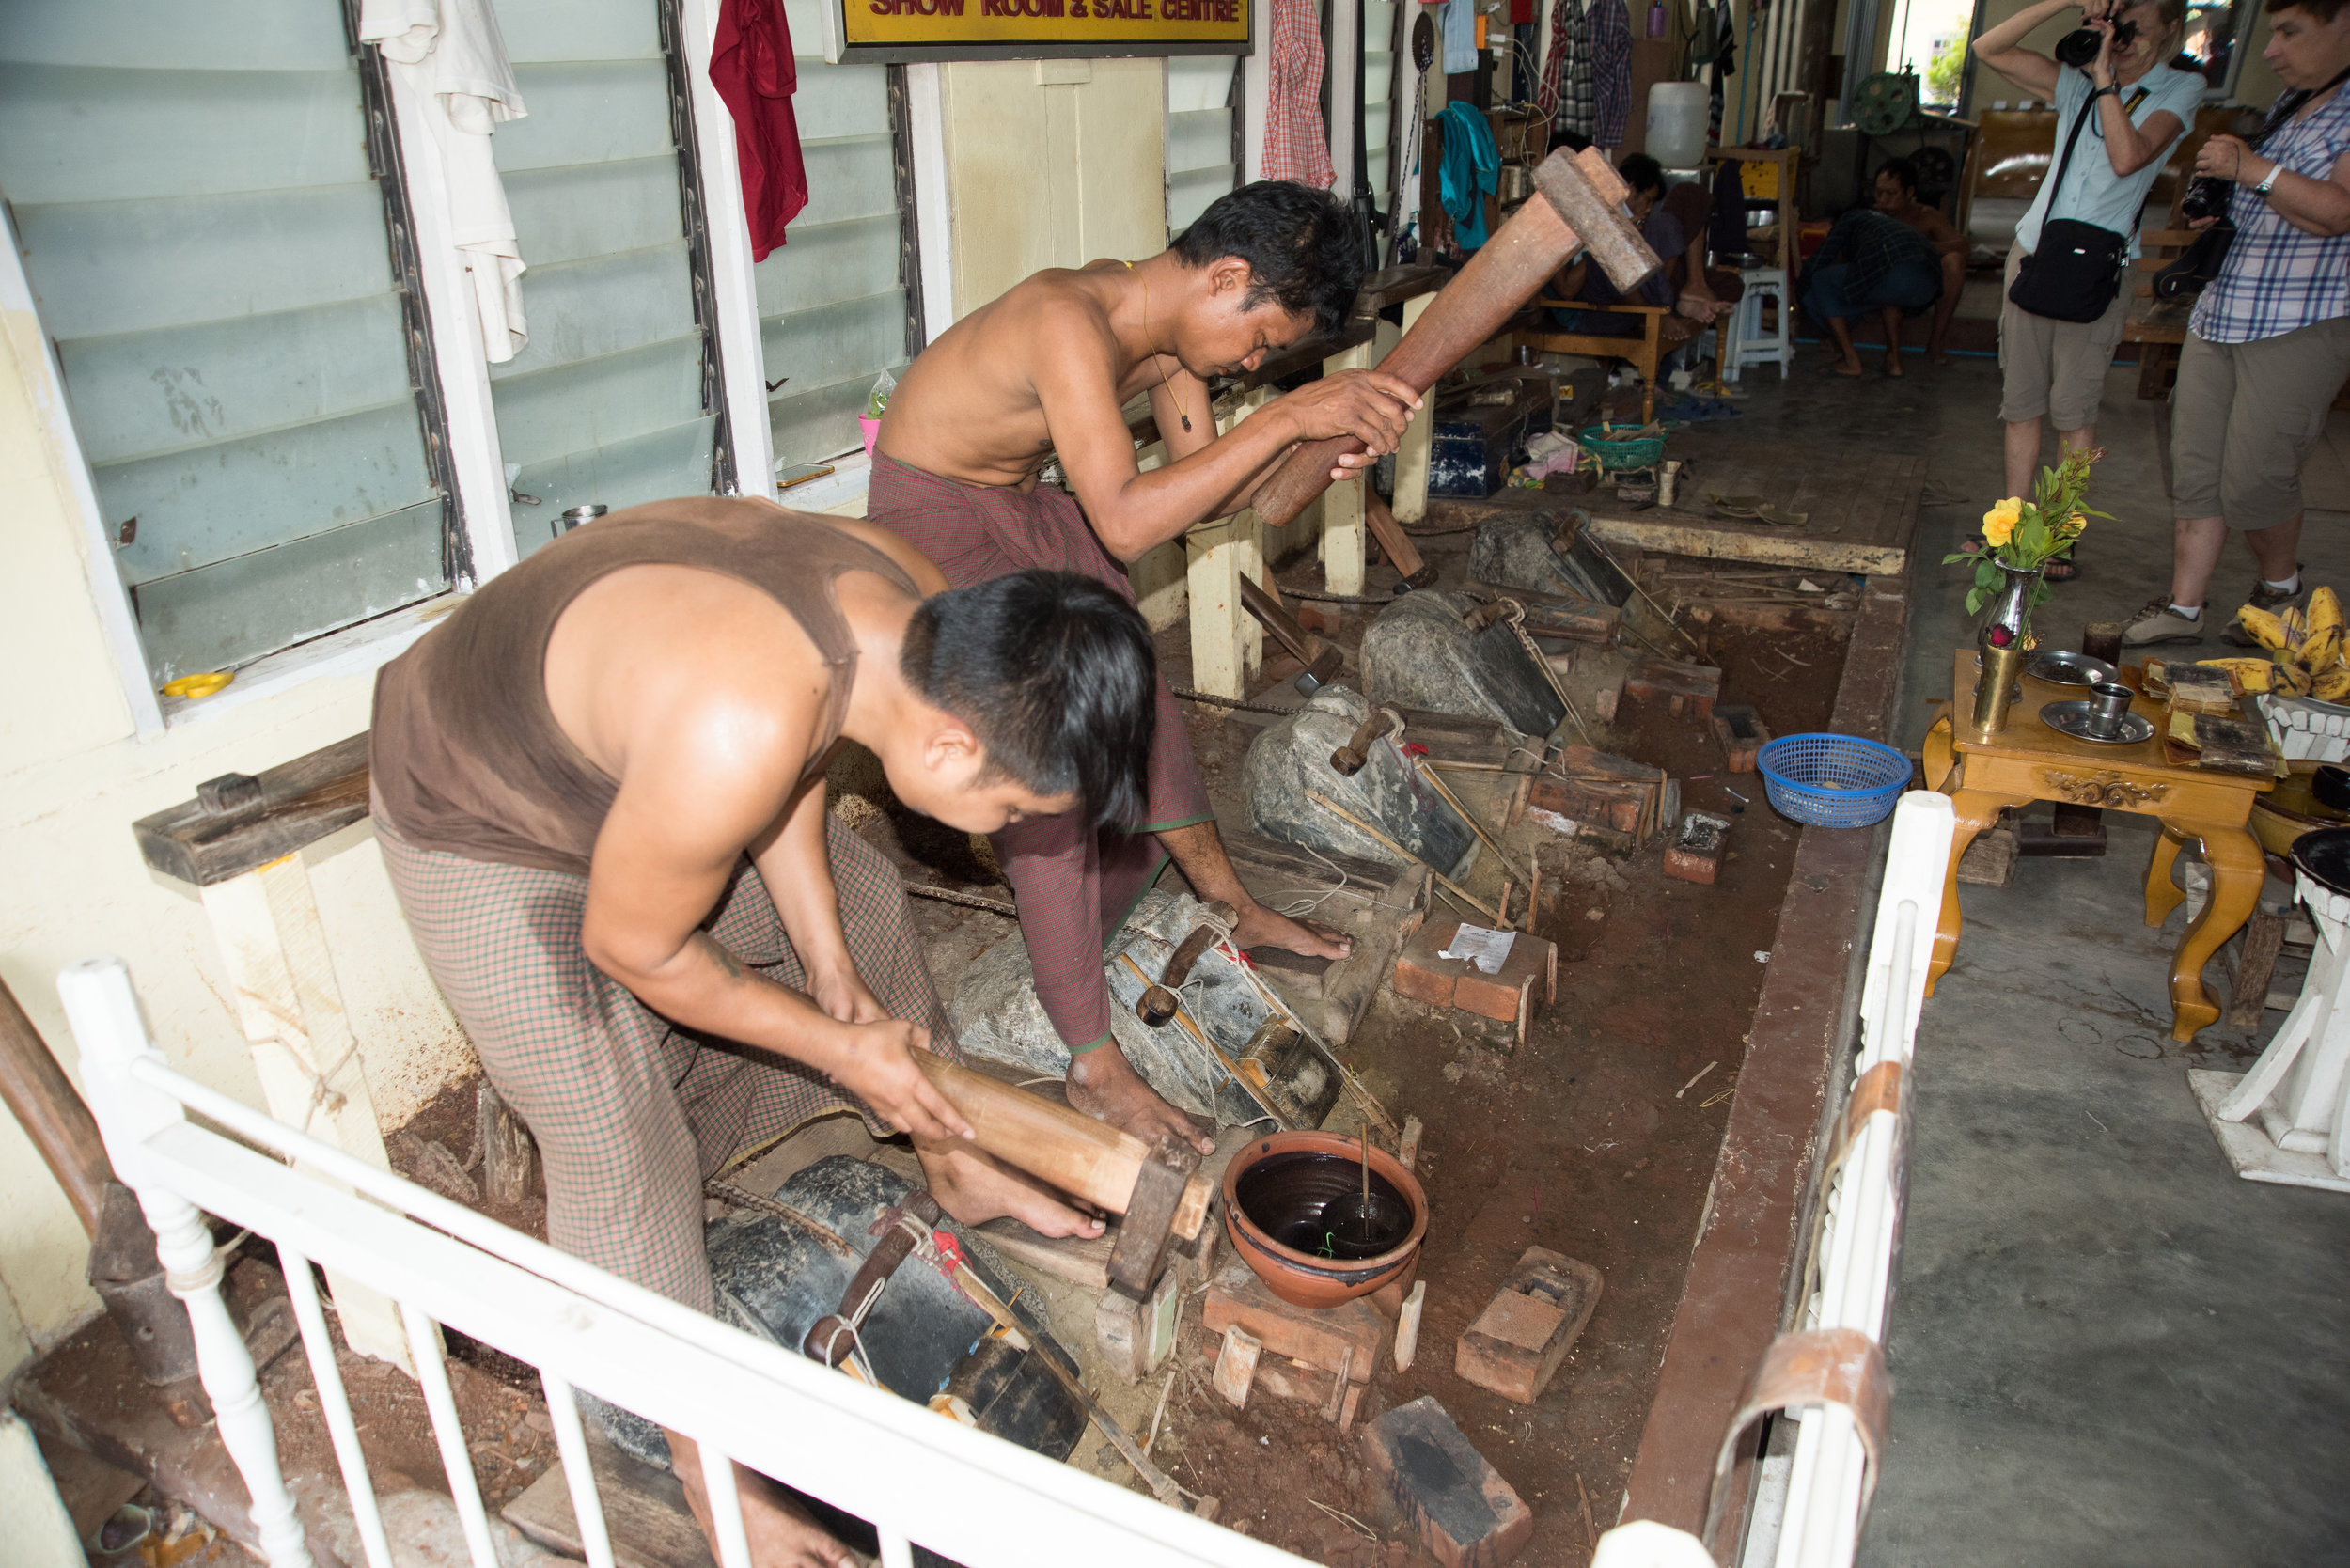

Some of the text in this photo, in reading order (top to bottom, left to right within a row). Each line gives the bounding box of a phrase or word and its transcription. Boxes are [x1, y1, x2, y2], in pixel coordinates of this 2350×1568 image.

[870, 0, 1240, 22] SHOW ROOM & SALE CENTRE
